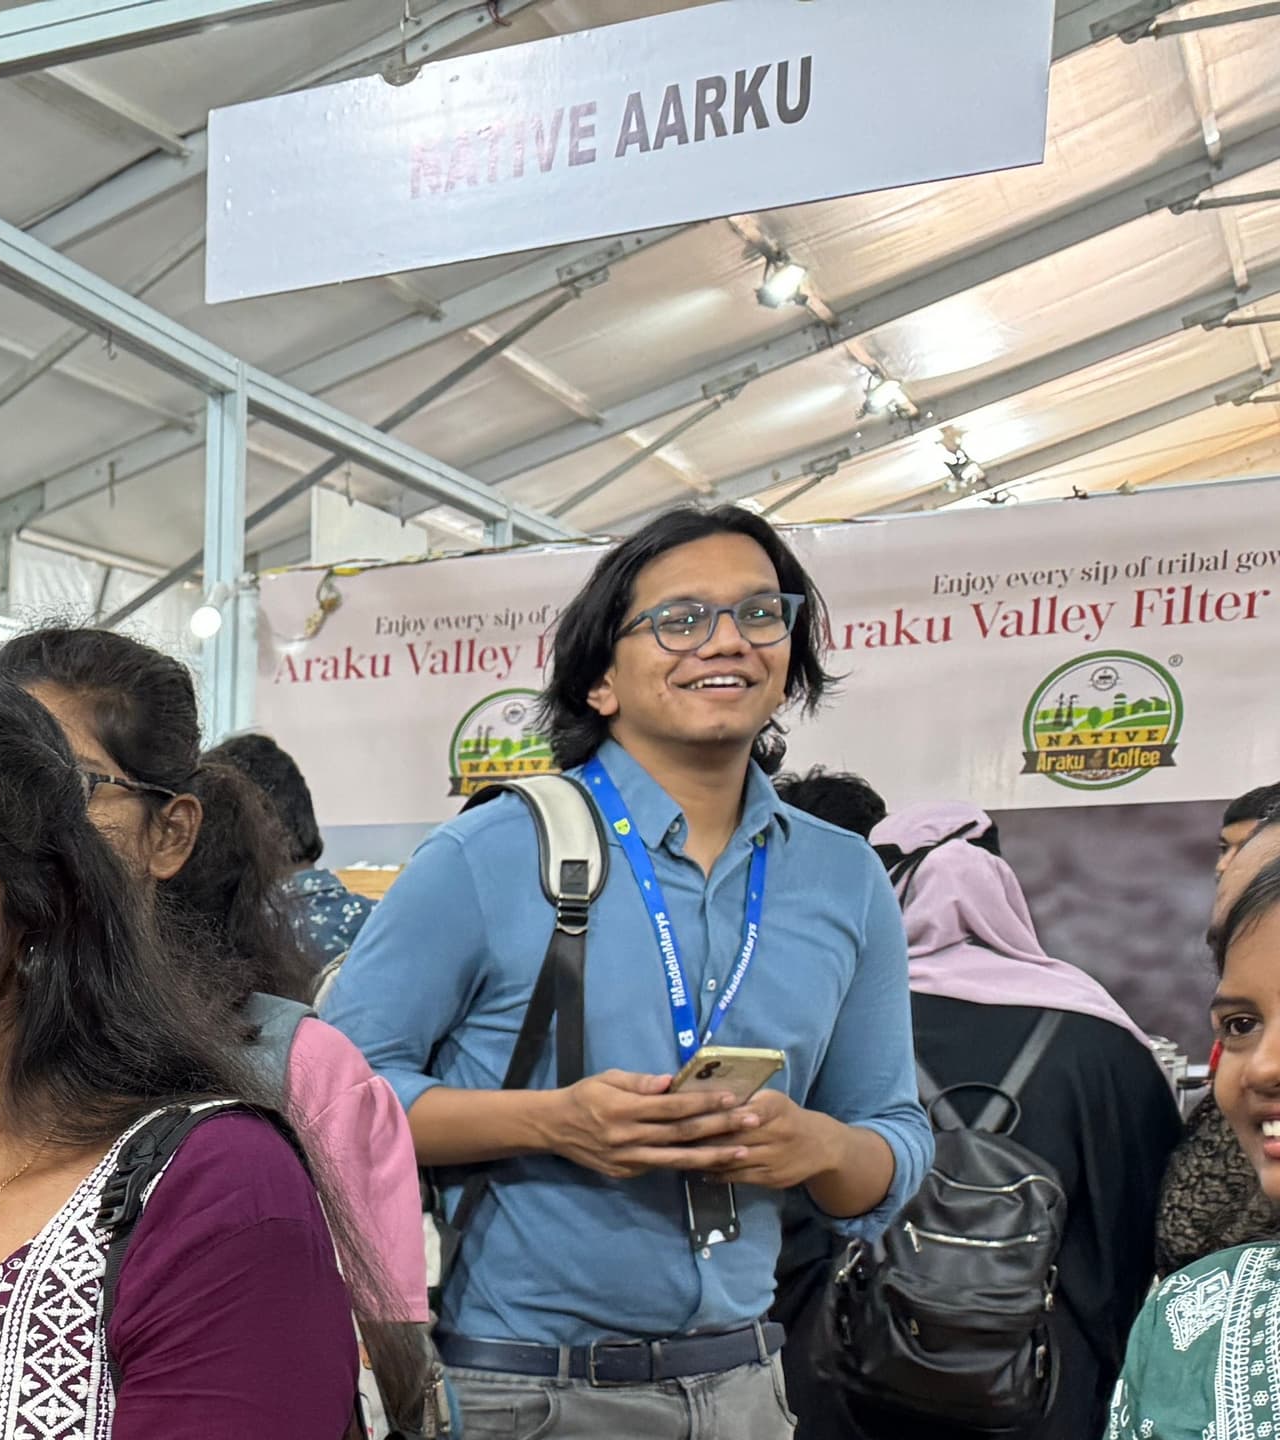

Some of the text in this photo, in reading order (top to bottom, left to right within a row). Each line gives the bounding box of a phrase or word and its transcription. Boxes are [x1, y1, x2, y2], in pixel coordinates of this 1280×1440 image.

[409, 56, 812, 199] NATIVE AARKU
[933, 572, 999, 597] Enjoy
[1006, 567, 1074, 588] every
[1080, 561, 1118, 586] sip
[1124, 556, 1152, 579] of
[1157, 549, 1228, 577] tribal
[376, 605, 550, 636] Enjoy every sip of
[970, 594, 1118, 642] Valley
[1130, 583, 1271, 629] Filter
[274, 646, 391, 684] Araku
[406, 638, 520, 680] Valley
[1036, 747, 1161, 773] Araku Coffee
[1046, 728, 1160, 747] NATIVE
